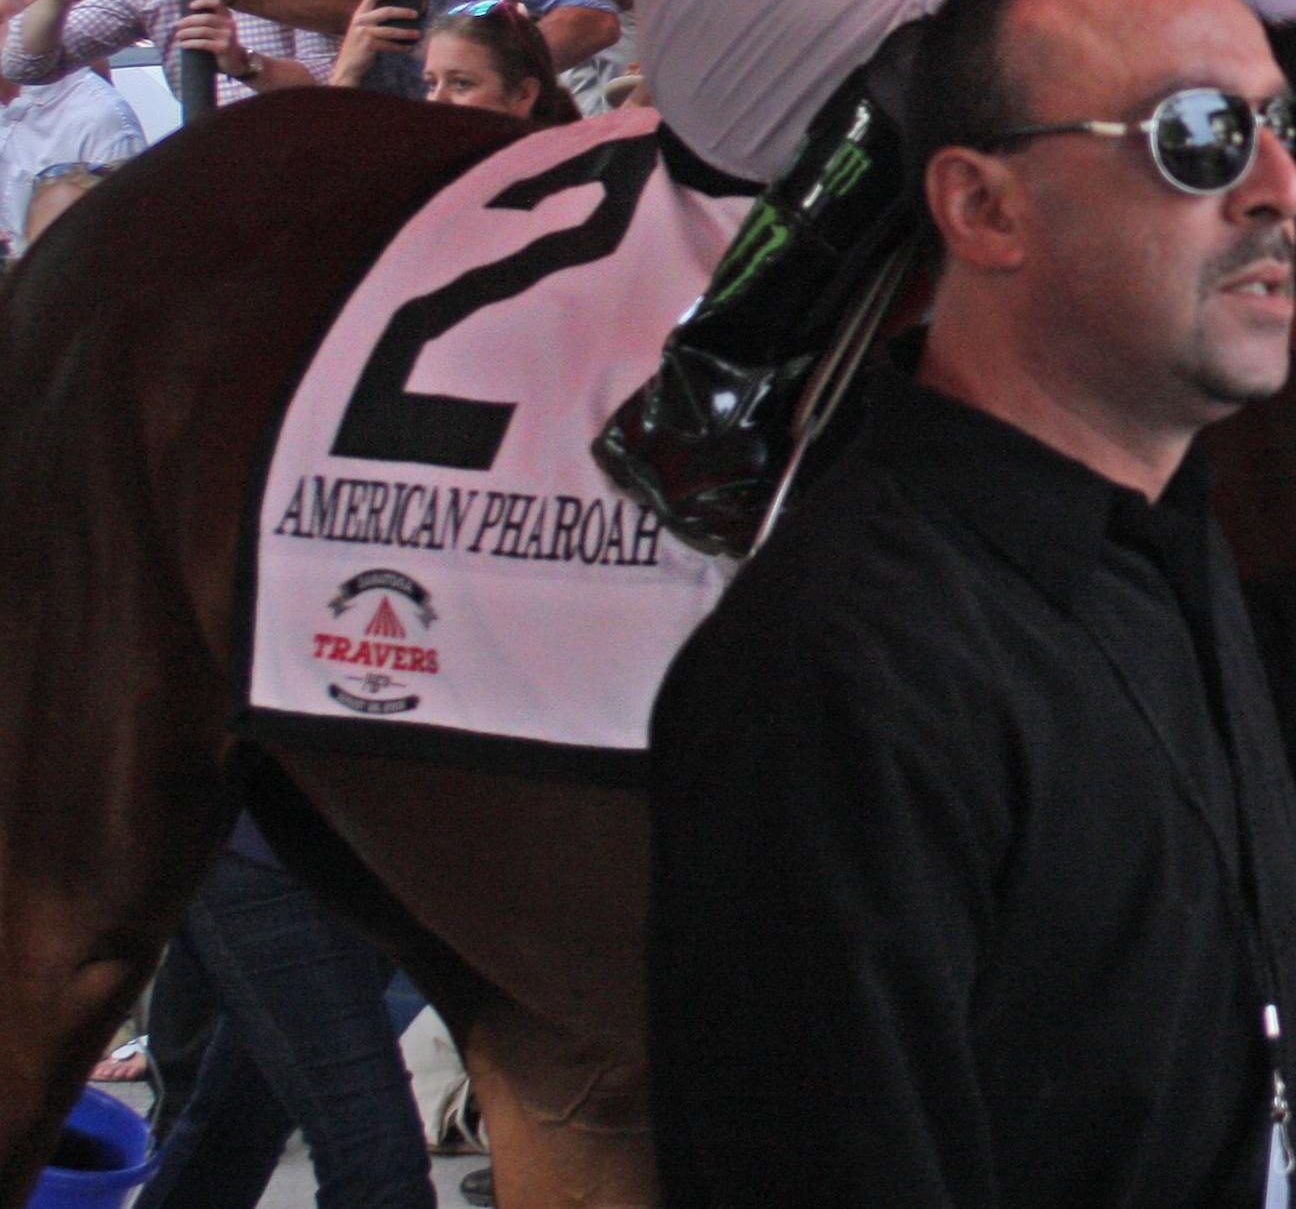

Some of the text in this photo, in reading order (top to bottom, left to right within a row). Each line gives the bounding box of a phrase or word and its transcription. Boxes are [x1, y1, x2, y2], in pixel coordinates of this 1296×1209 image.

[328, 132, 659, 471] 2
[273, 475, 661, 566] AMERICAN PHAROAH
[313, 633, 440, 675] TRAVERS
